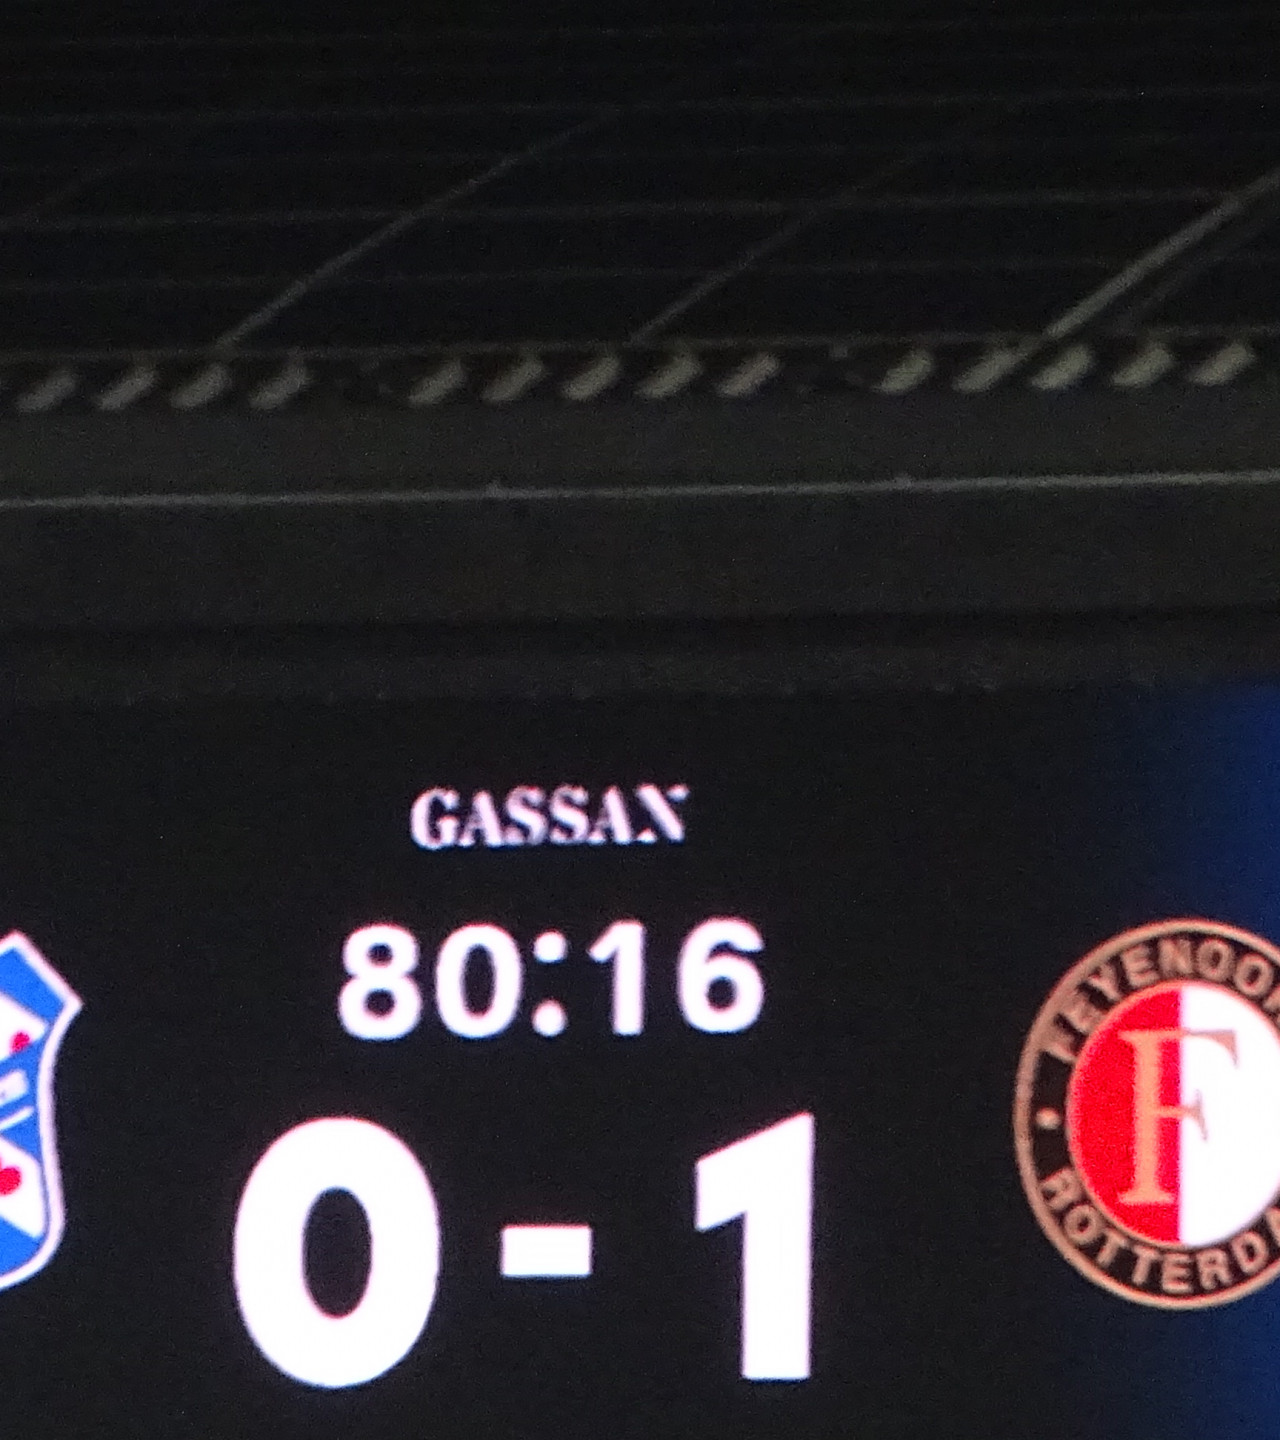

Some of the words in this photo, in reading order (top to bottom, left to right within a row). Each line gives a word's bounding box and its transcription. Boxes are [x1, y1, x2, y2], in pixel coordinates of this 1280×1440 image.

[410, 784, 689, 850] GASSAN
[338, 917, 764, 1041] 80:16
[1120, 1028, 1239, 1206] F
[233, 1116, 441, 1388] 0
[694, 1111, 815, 1380] 1
